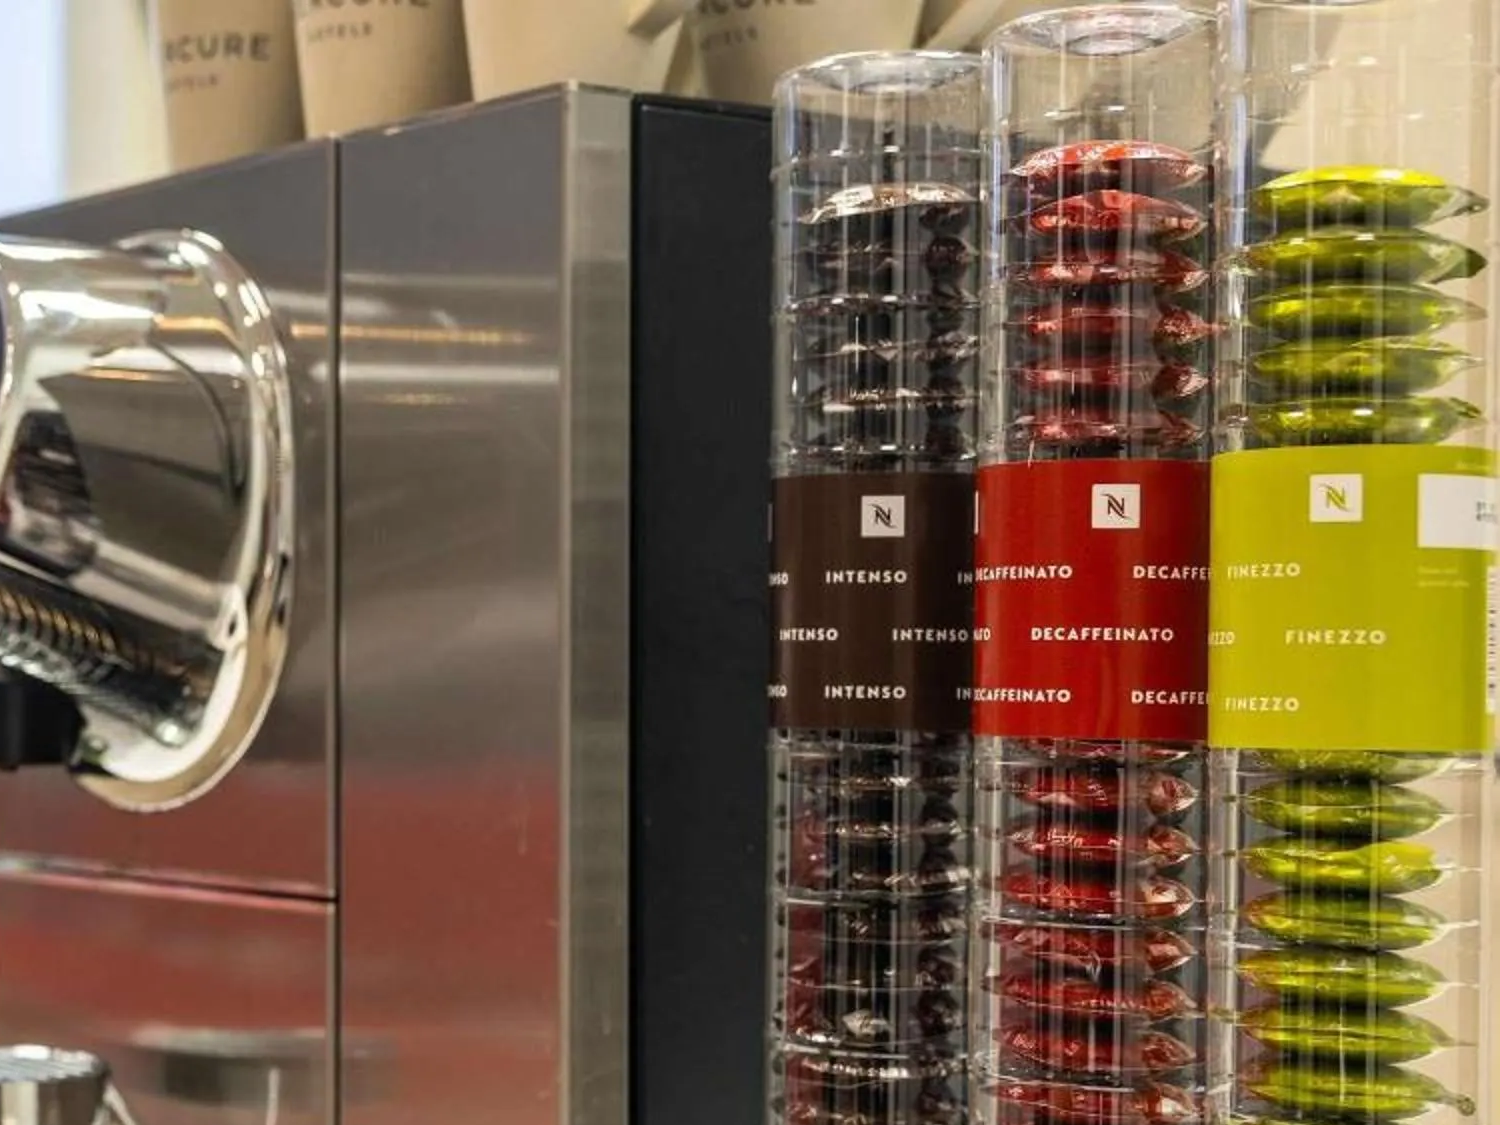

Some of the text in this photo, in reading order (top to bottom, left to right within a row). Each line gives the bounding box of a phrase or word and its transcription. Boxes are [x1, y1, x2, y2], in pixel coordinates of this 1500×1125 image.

[825, 569, 908, 584] INTENSO
[1227, 562, 1301, 580] FINEZZO
[779, 627, 839, 641] INTENSO
[891, 627, 969, 642] INTENSO
[1031, 627, 1174, 642] DECAFFEINATO
[1285, 629, 1387, 646] FINEZZO
[824, 685, 907, 699] INTENSO
[1225, 696, 1301, 712] FINEZZO
